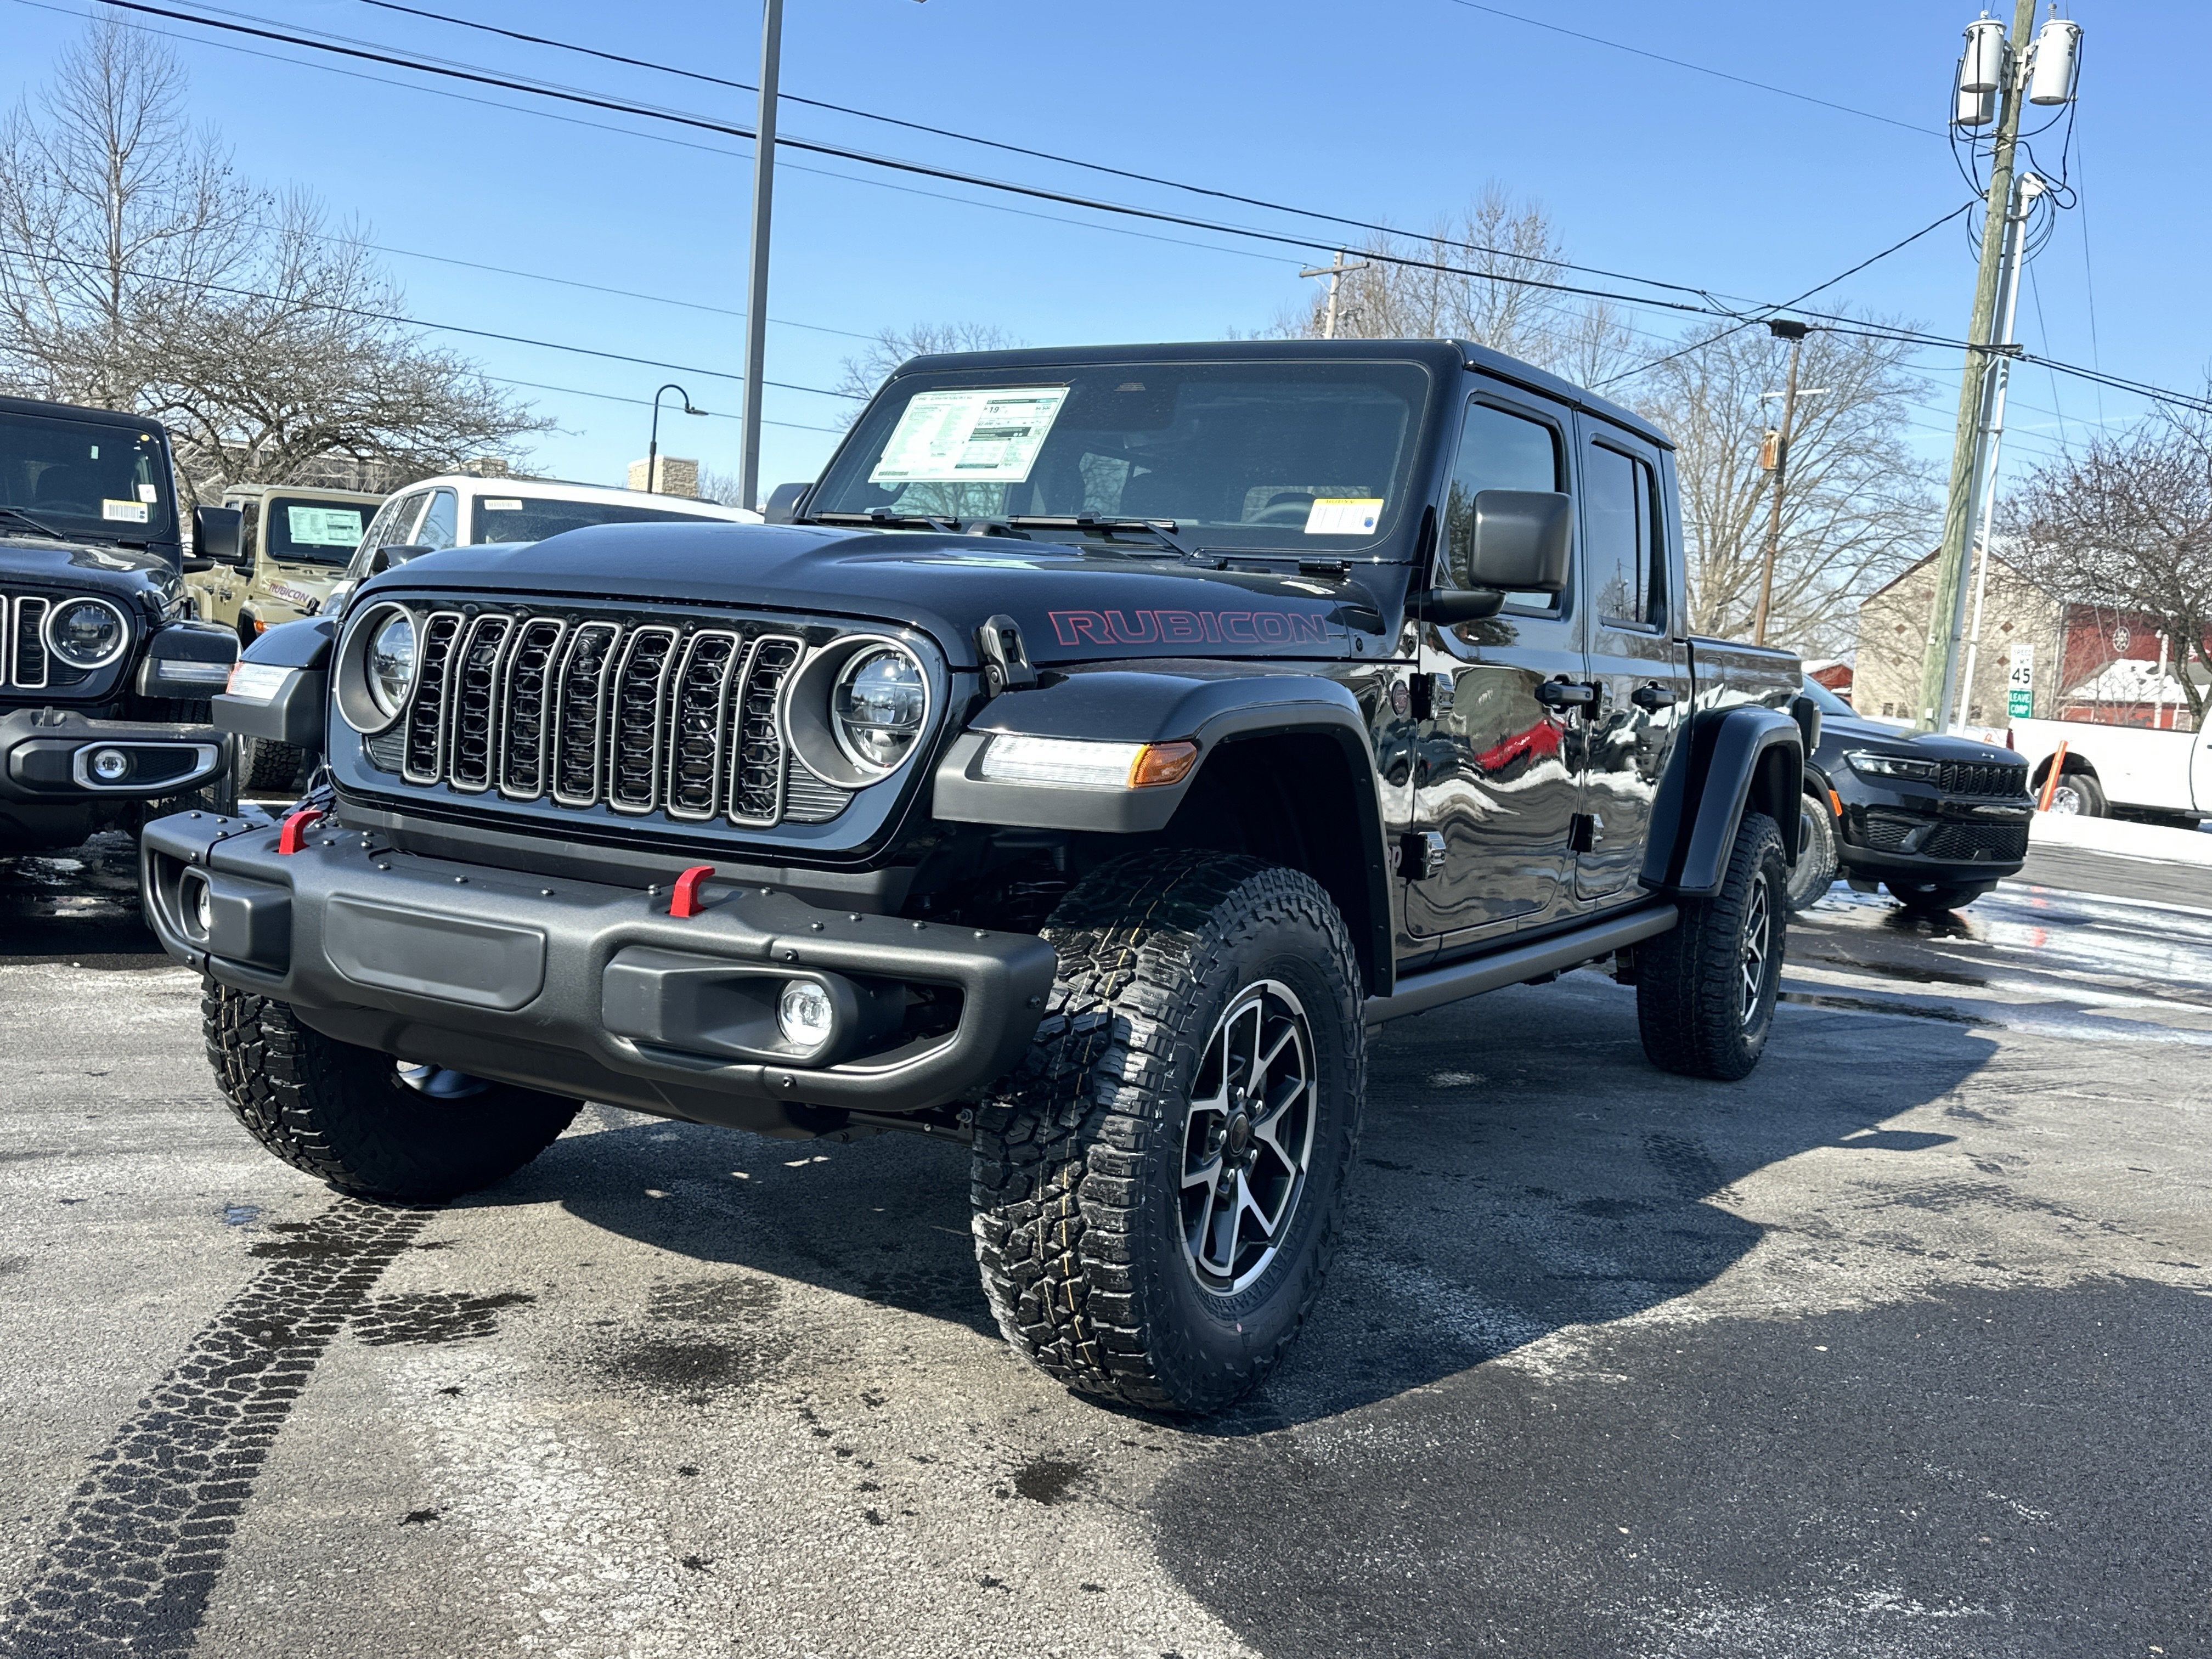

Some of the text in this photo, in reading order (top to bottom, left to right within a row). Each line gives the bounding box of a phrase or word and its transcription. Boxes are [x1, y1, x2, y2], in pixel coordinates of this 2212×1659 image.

[269, 583, 309, 602] RUBICON
[1047, 610, 1329, 646] RUBICON
[2011, 668, 2030, 684] 45
[2010, 692, 2030, 703] LEAVE
